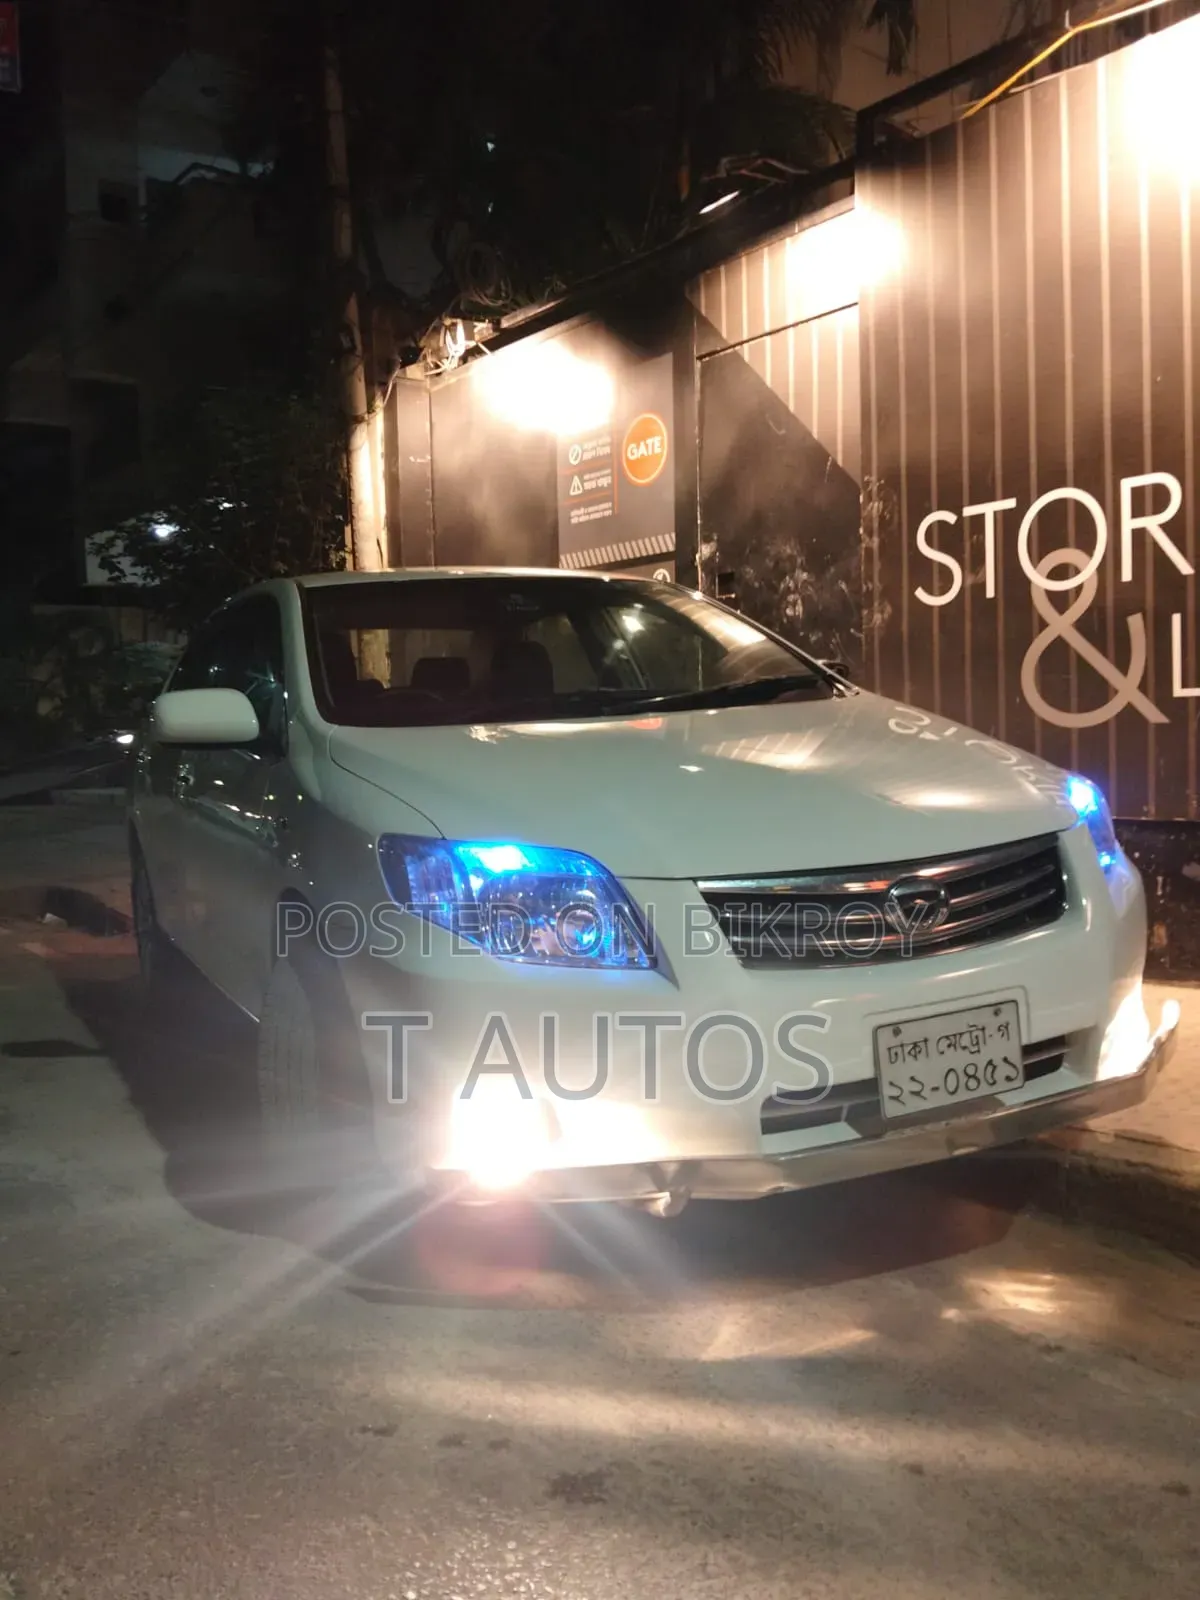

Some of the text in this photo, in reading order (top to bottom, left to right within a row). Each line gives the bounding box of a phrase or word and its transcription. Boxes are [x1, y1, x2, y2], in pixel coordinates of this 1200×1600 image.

[627, 436, 663, 461] GATE
[914, 471, 1195, 606] STOR
[1020, 547, 1170, 729] &
[887, 1037, 929, 1065] ঢাকা
[887, 1055, 1020, 1106] ২২-০৪৫১
